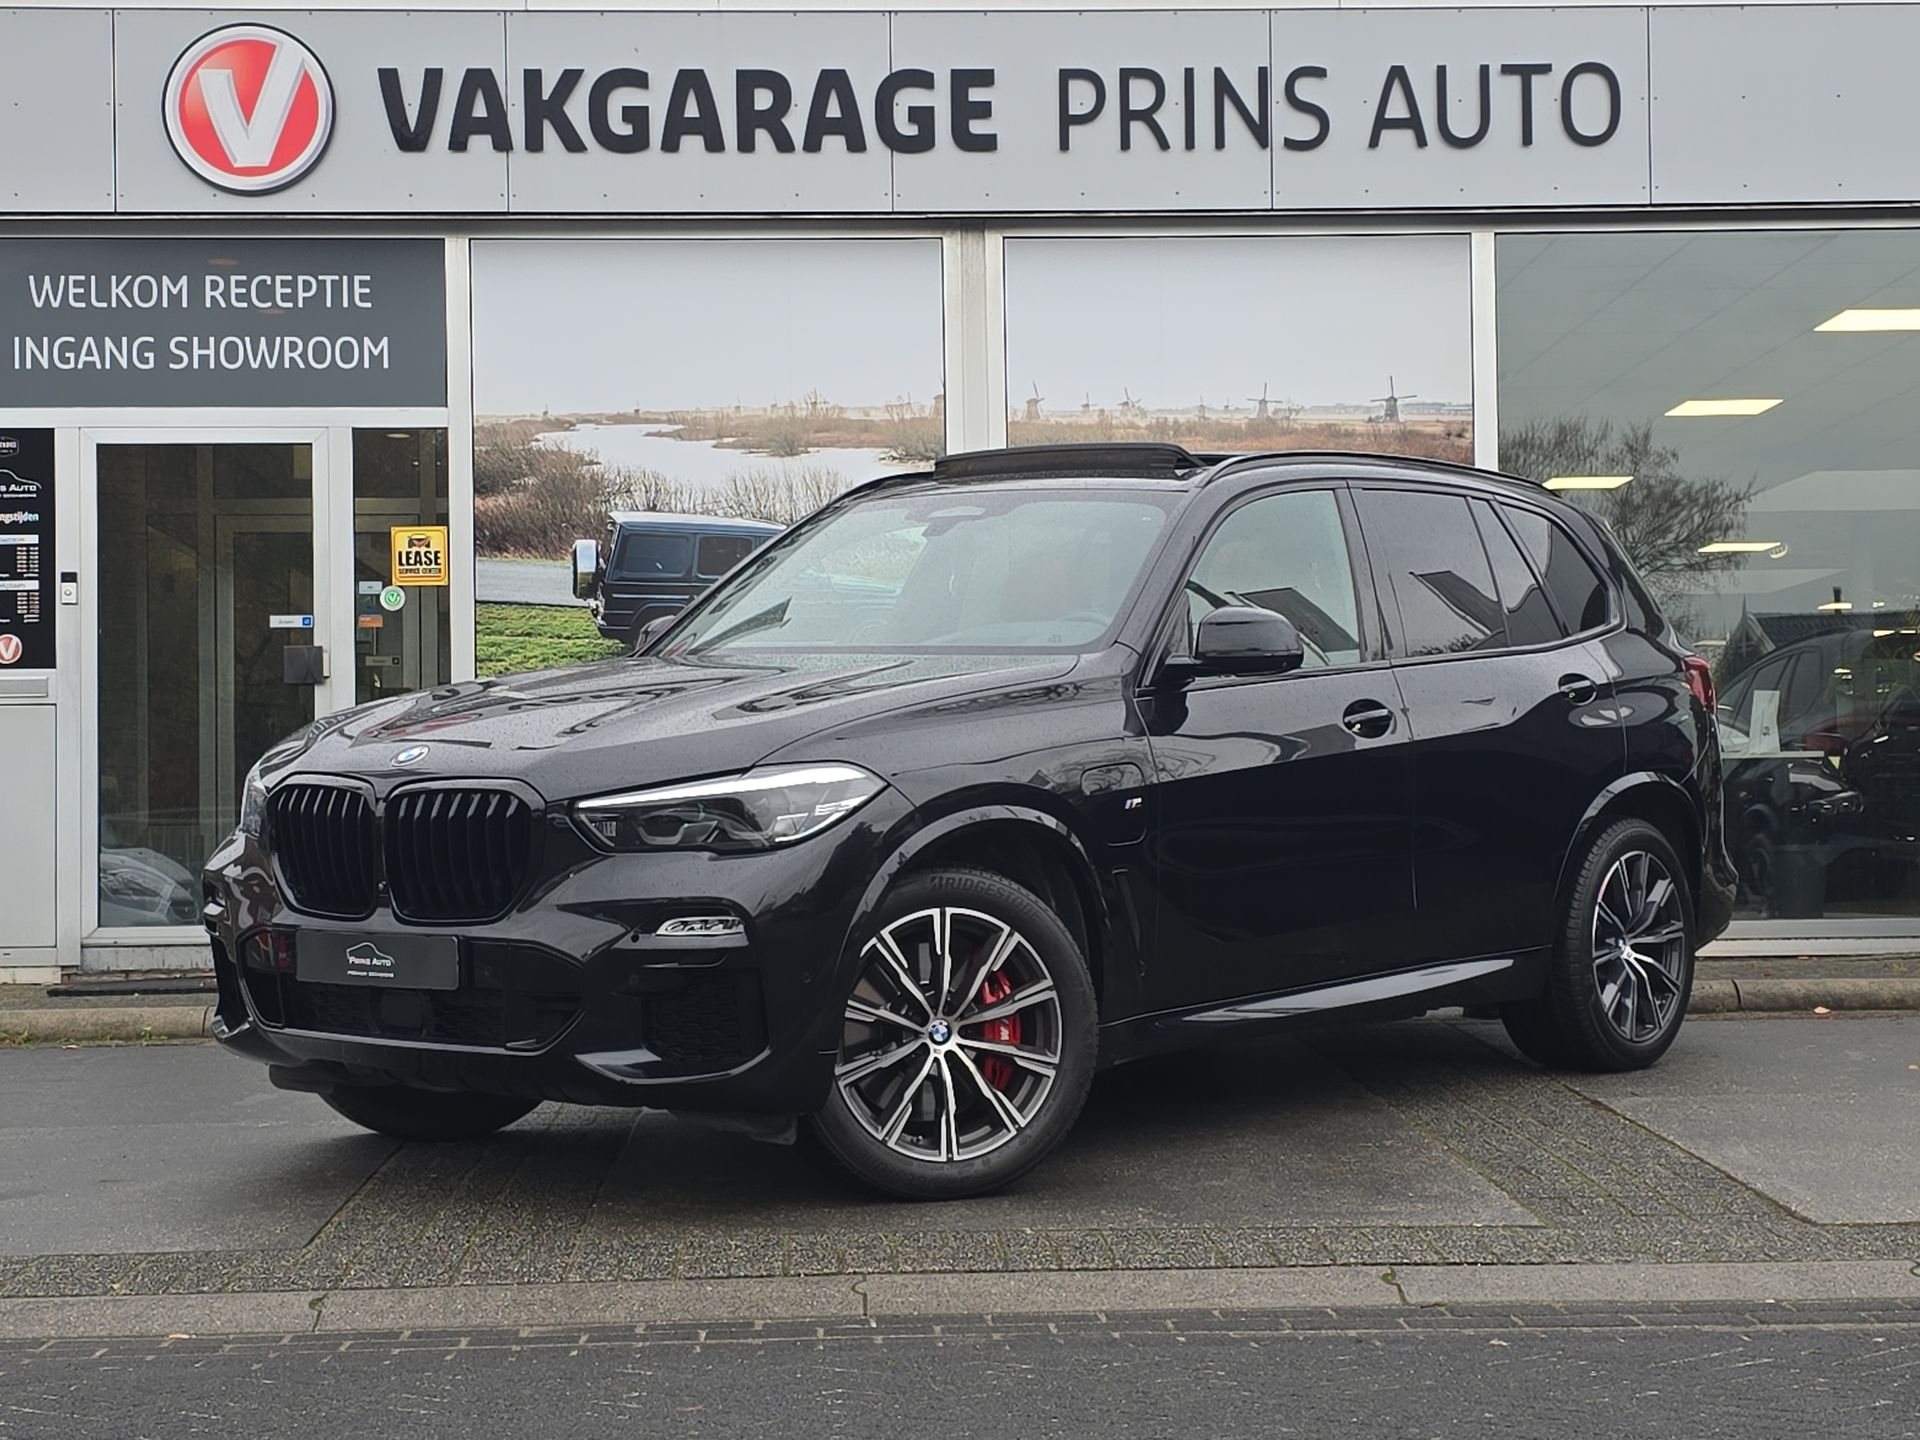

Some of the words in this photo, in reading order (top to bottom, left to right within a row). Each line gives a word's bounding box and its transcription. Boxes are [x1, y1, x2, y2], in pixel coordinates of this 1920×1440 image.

[377, 66, 998, 155] VAKGARAGE
[1058, 65, 1330, 152] PRINS
[1367, 61, 1622, 149] AUTO
[28, 274, 189, 309] WELKOM
[204, 274, 373, 309] RECEPTIE
[13, 335, 155, 370] INGANG
[168, 335, 390, 370] SHOWROOM
[398, 550, 442, 567] LEASE
